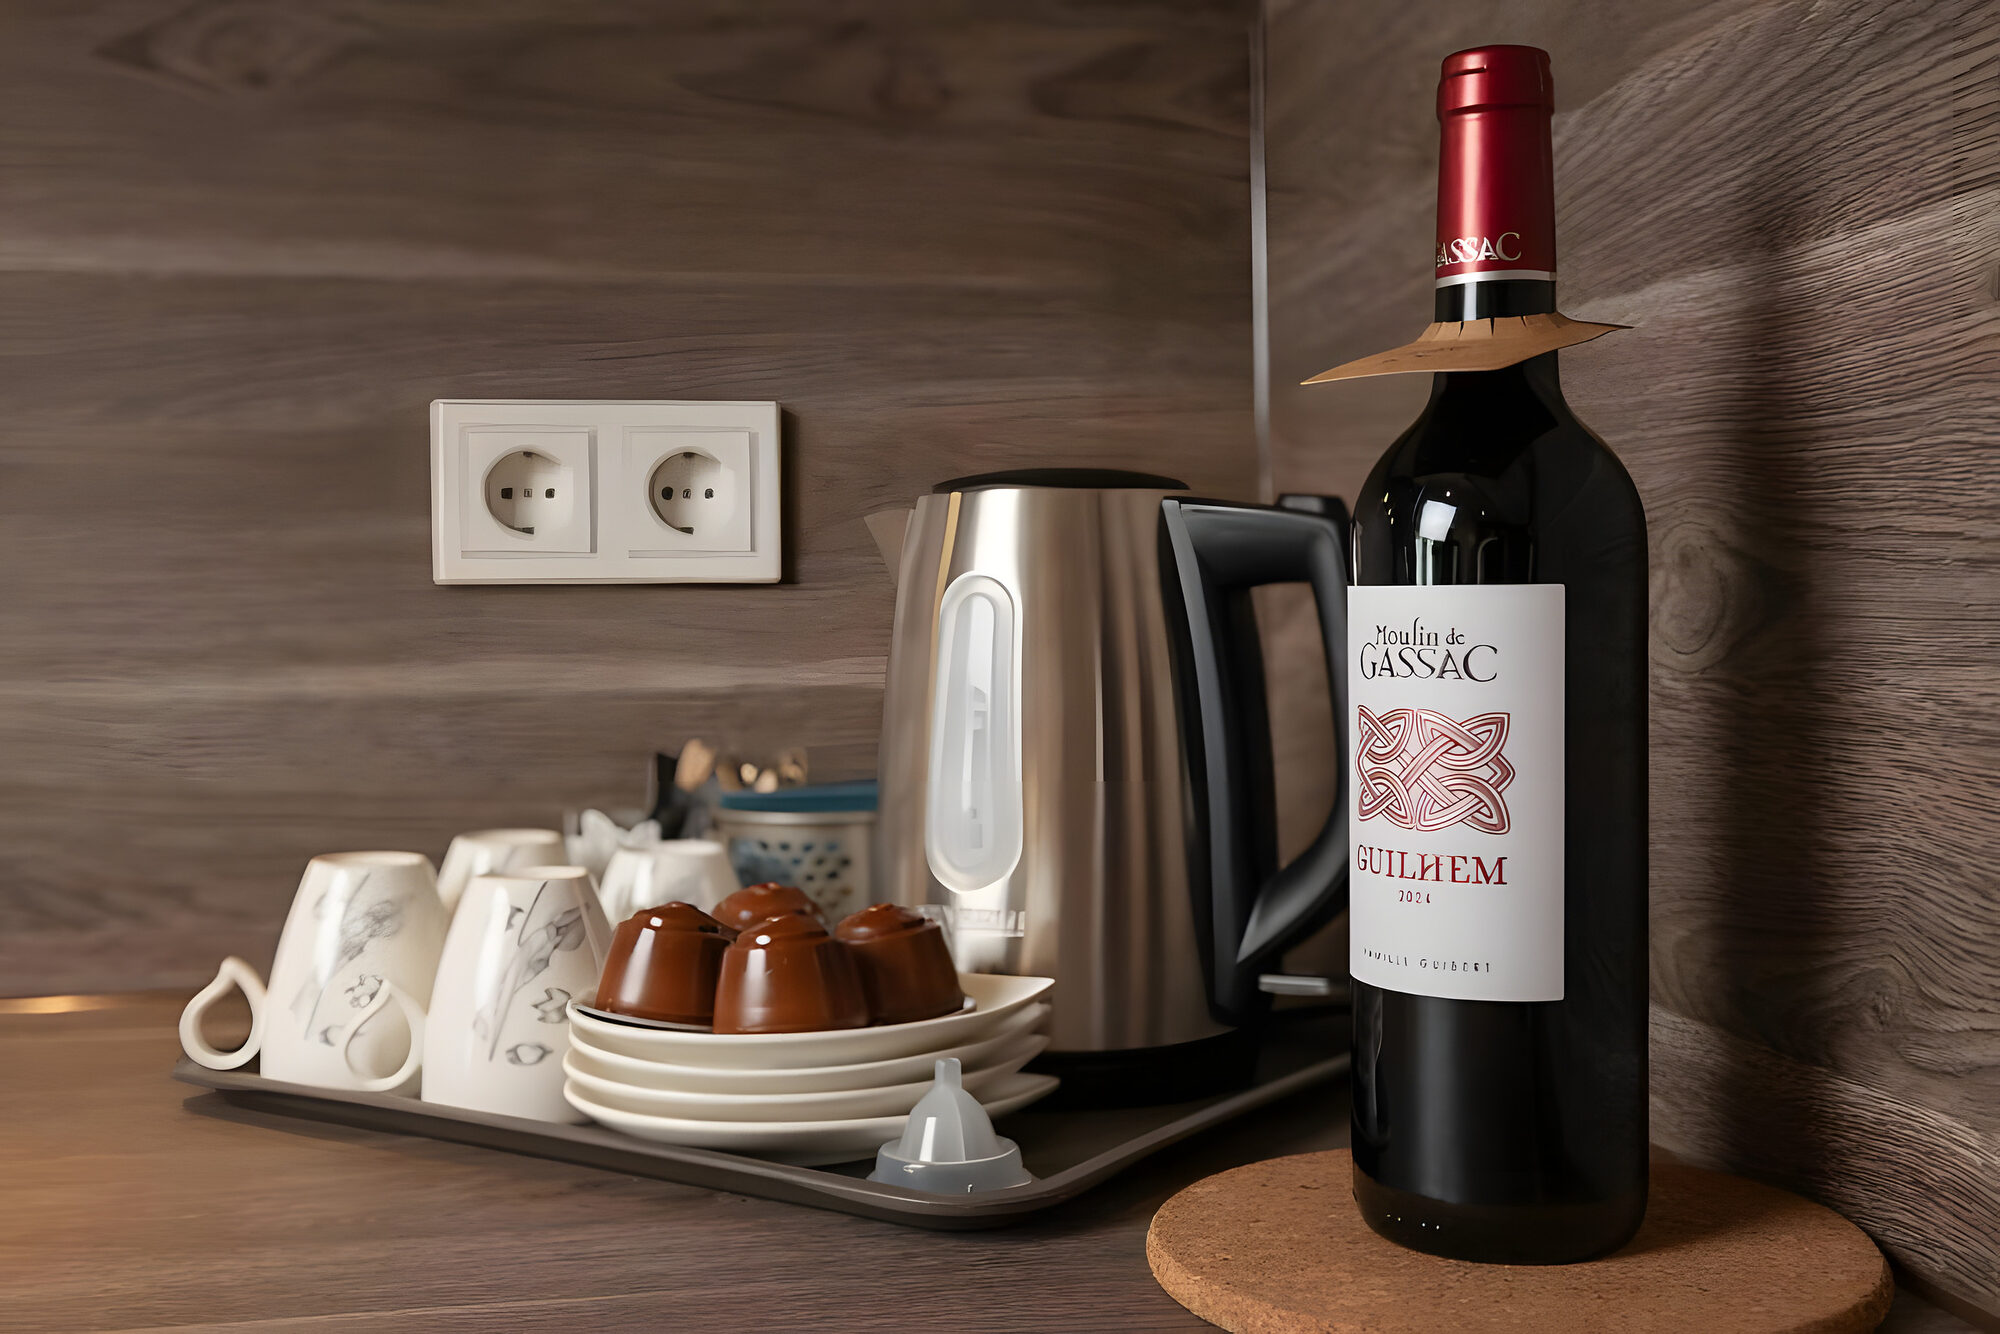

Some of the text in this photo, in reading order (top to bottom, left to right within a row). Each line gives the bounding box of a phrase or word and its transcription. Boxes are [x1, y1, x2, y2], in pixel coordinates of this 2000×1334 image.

[1436, 232, 1522, 267] ASSAC
[1375, 616, 1466, 647] Moulin de
[1360, 642, 1498, 682] GASSAC
[1357, 844, 1508, 885] GUILHEM
